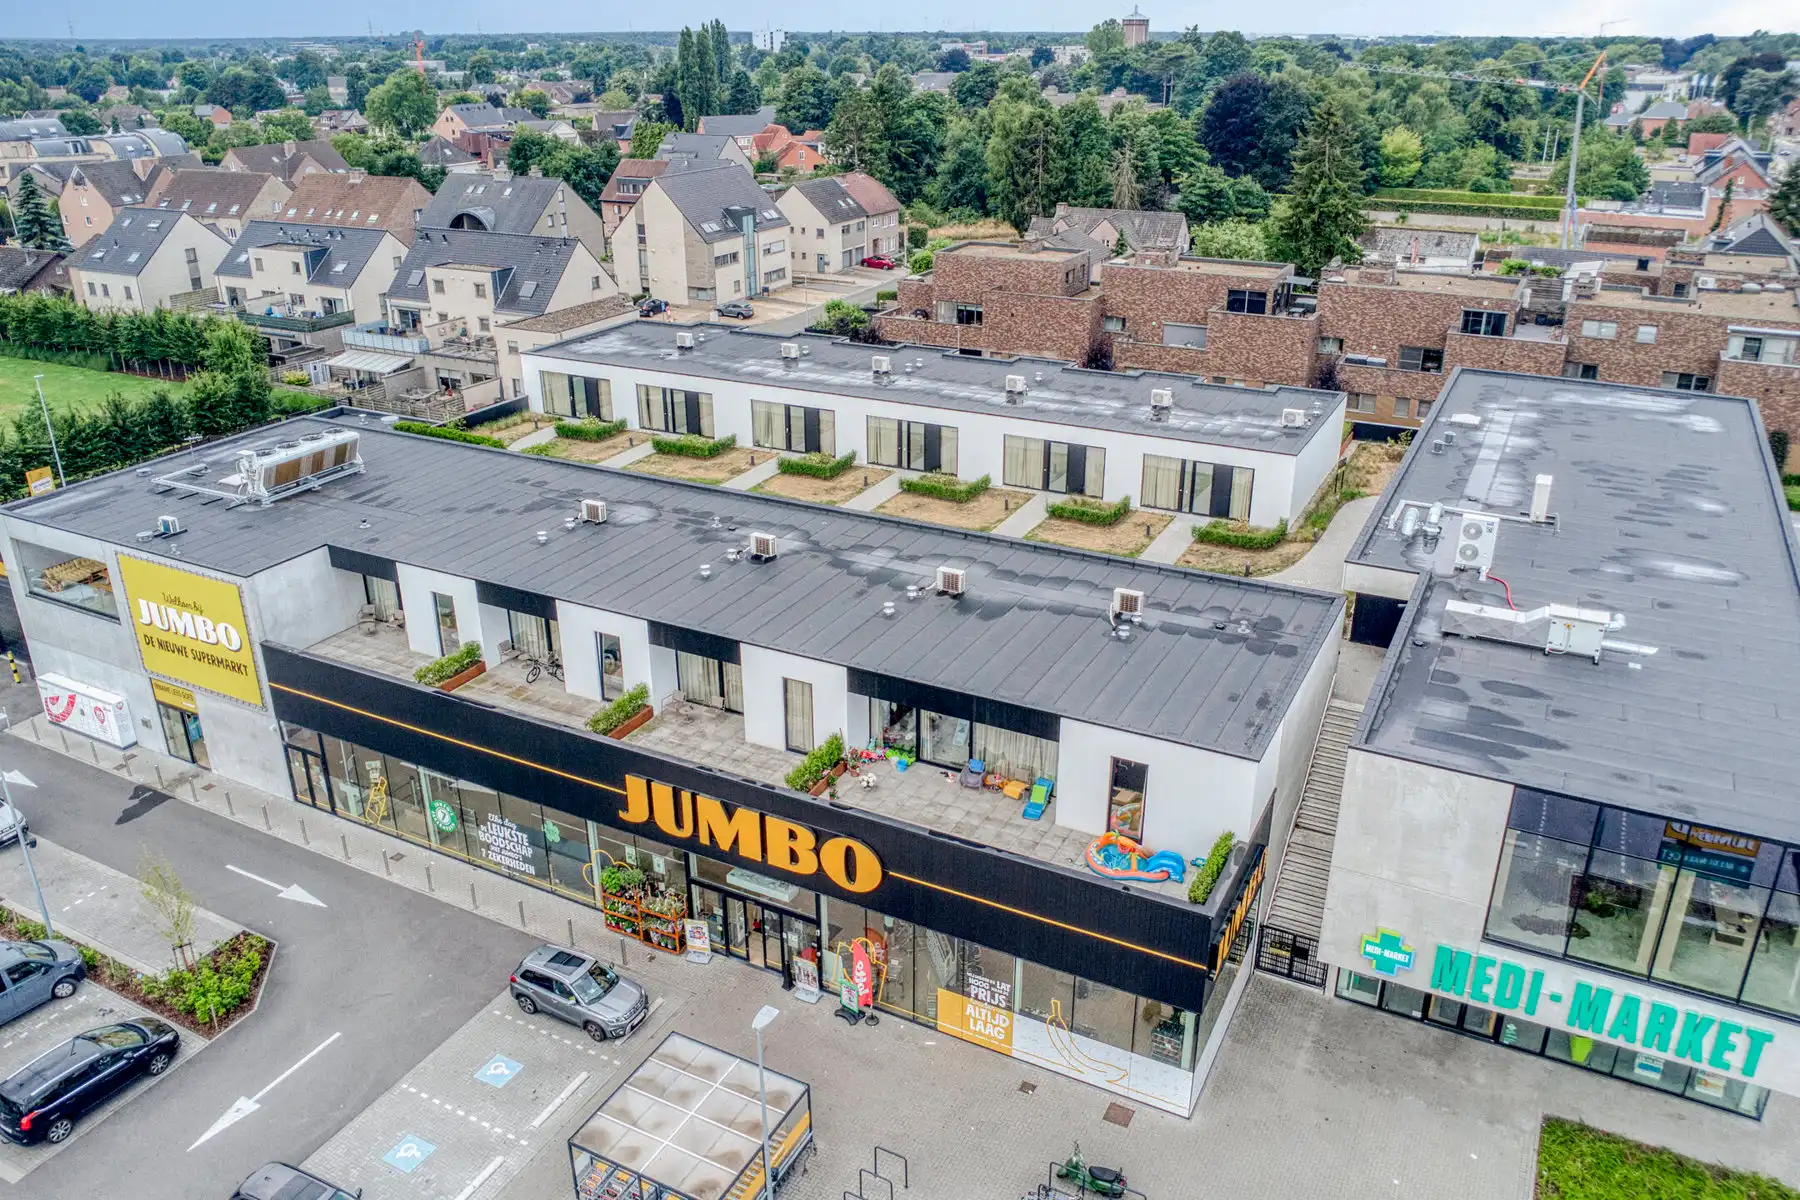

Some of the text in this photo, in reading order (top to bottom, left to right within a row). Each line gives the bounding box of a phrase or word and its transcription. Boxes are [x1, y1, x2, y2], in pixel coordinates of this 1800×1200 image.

[138, 598, 242, 652] JUMBO
[143, 634, 248, 676] DE NIEUWE SUPERMARKT
[478, 830, 533, 858] BOODSCHAP
[487, 821, 529, 846] LEUKSTE
[619, 773, 883, 893] JUMBO
[481, 848, 487, 858] 7
[487, 850, 536, 876] ZEKERHEDEN
[1365, 943, 1409, 963] MEDI-MARKET
[968, 977, 990, 990] HOOG
[970, 984, 1006, 1008] PRIJS
[996, 980, 1011, 993] LAT
[966, 1003, 1010, 1028] ALTIJD
[1430, 943, 1775, 1079] MEDI-MARKET
[970, 1017, 1005, 1040] LAAG
